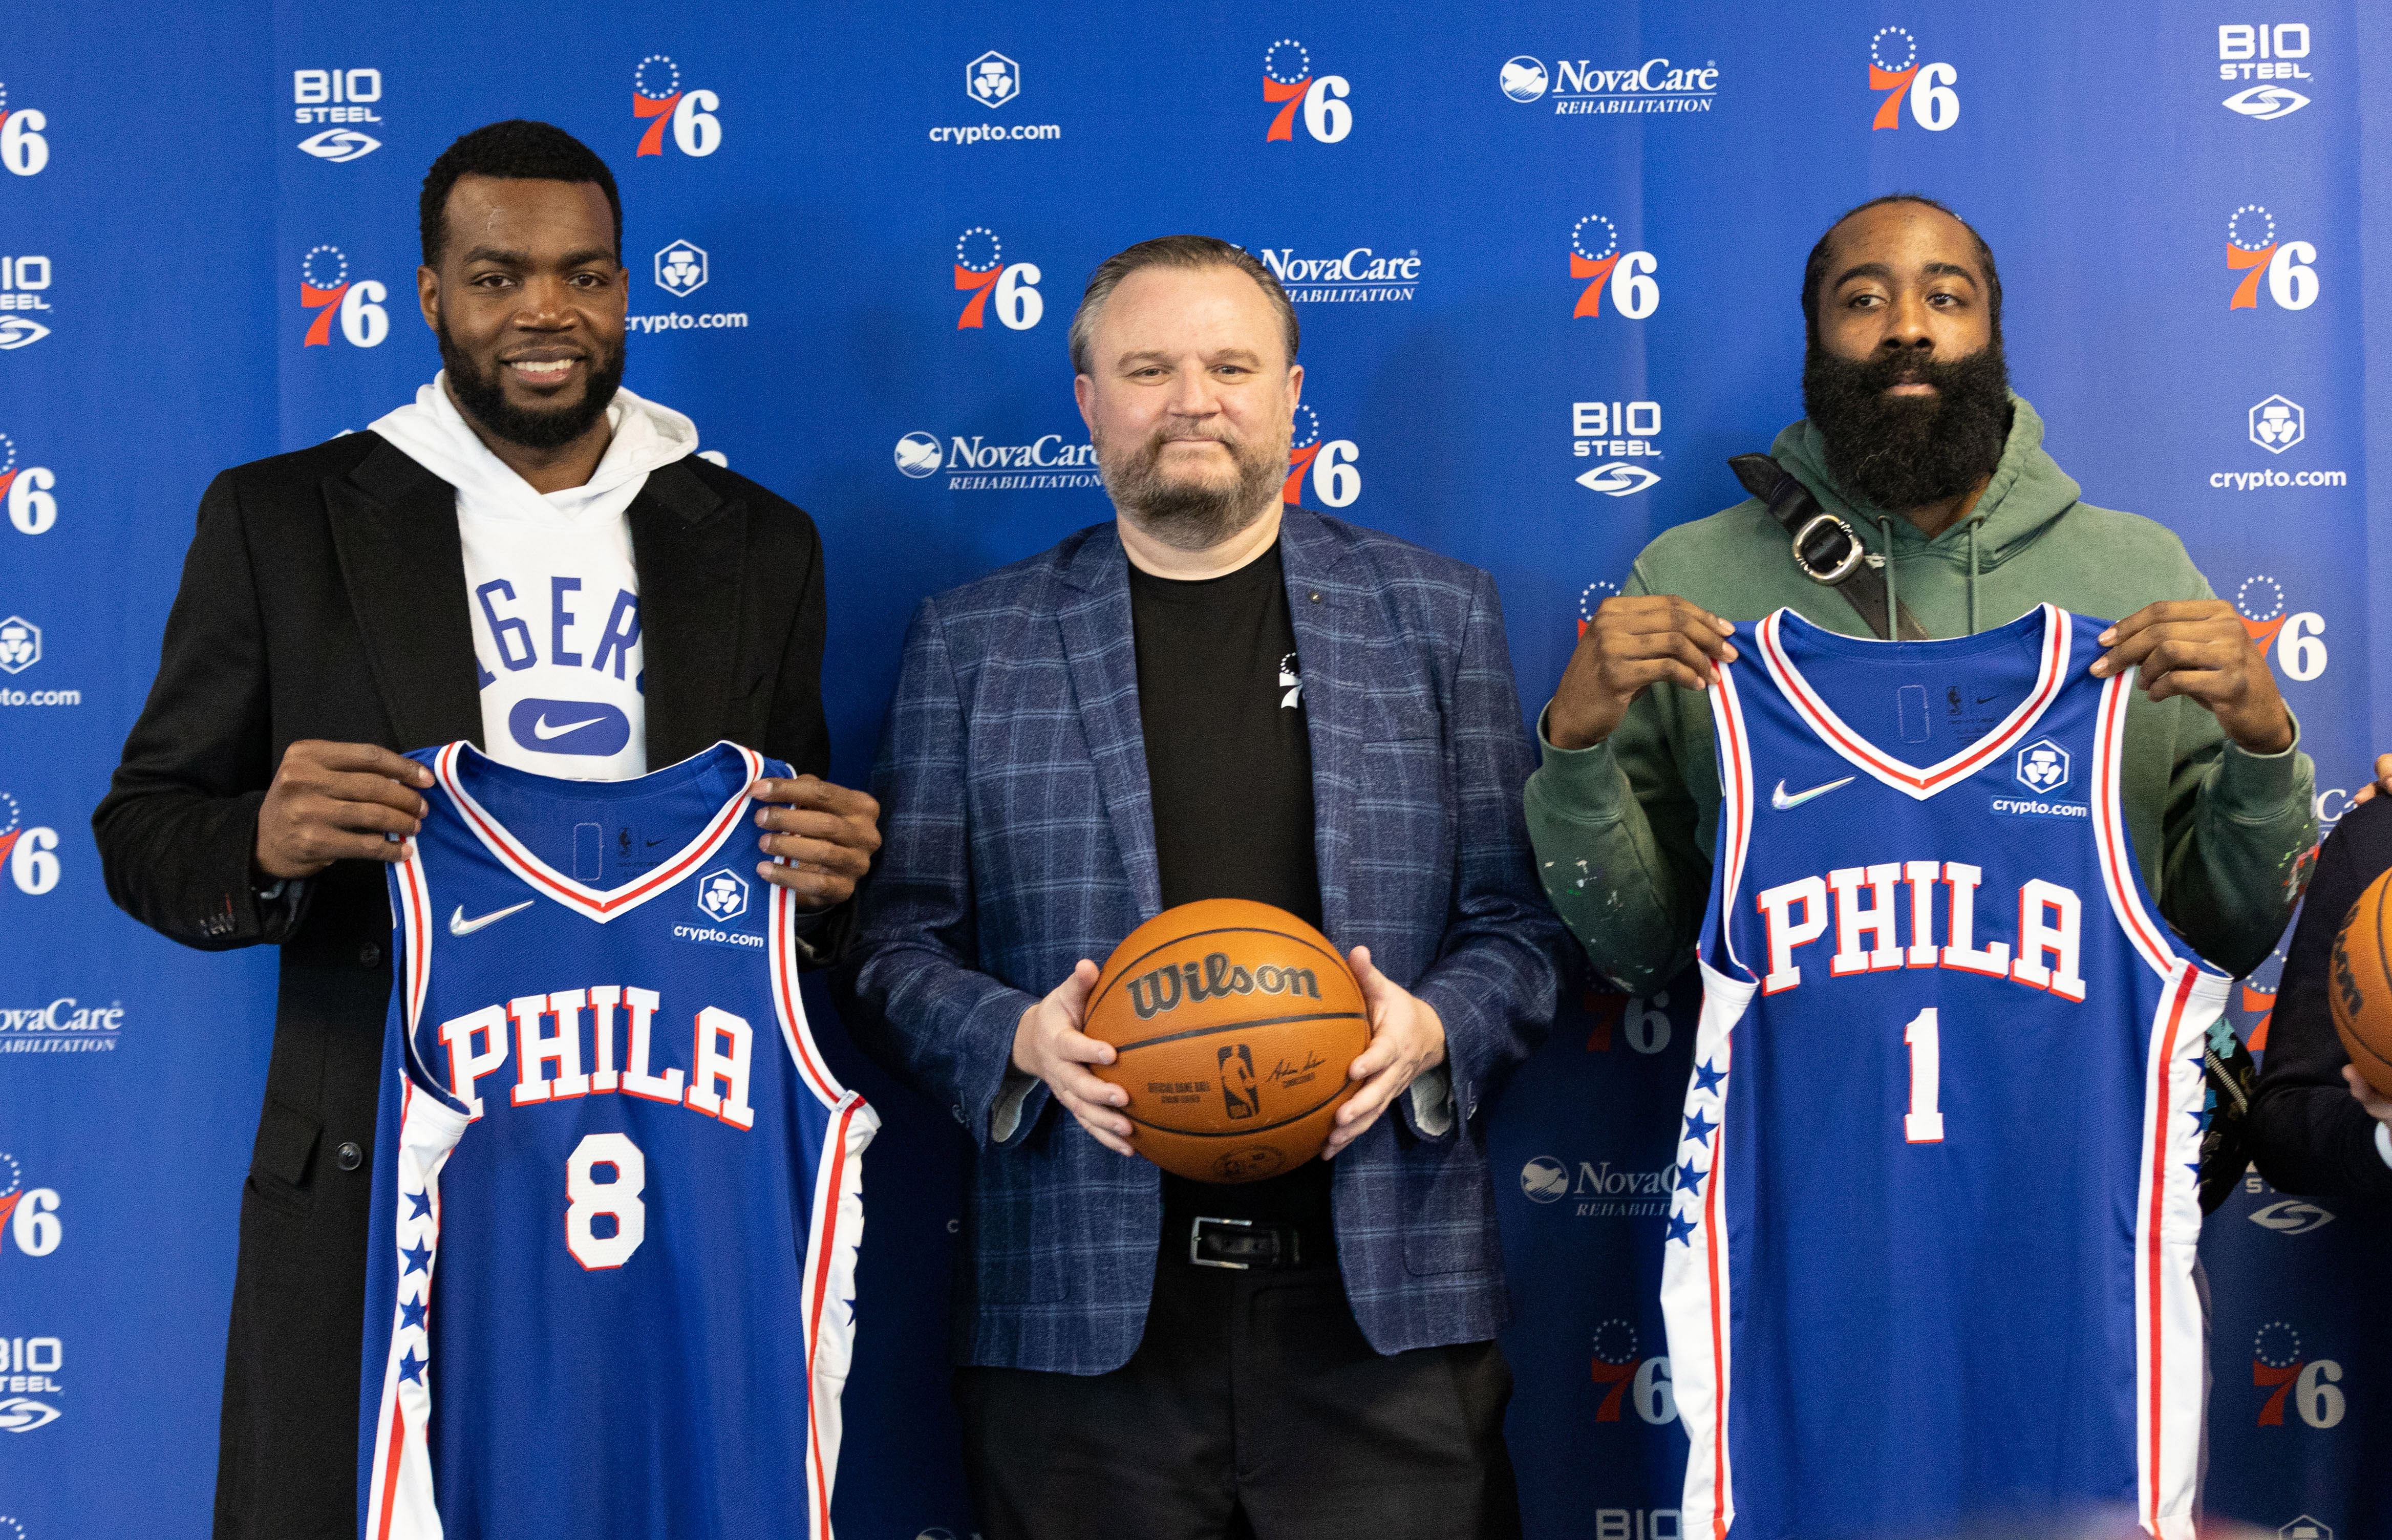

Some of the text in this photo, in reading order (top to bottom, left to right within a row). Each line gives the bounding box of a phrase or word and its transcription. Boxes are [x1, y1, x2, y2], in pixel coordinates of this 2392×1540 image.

[2218, 23, 2310, 60] BIO
[294, 68, 381, 104] BIO
[1553, 57, 1720, 92] NovaCare
[2220, 62, 2312, 81] STEEL
[1263, 75, 1353, 143] 76
[1555, 99, 1712, 115] REHABILITATION
[1869, 62, 1960, 131] 76
[295, 106, 382, 123] STEEL
[633, 89, 721, 158] 76
[0, 109, 49, 176] 6
[929, 123, 1060, 145] crypto.com
[1, 256, 51, 290] IO
[1261, 247, 1421, 281] NovaCare
[2226, 241, 2319, 310] 76
[0, 294, 51, 310] EEL
[954, 263, 1043, 330] 76
[1285, 288, 1415, 303] HABILITATION
[1570, 251, 1660, 319] 76
[301, 280, 389, 348] 76
[1573, 401, 1661, 436] BIO
[1573, 440, 1662, 457] STEEL
[2210, 468, 2346, 491] crypto.com
[476, 576, 644, 696] 6ER
[0, 687, 81, 706] to.com
[1279, 672, 1304, 709] 7
[1993, 800, 2087, 817] crypto.com
[674, 923, 764, 948] crypto.com
[1757, 861, 2086, 1003] PHILA
[1126, 952, 1322, 1020] Wilson
[0, 997, 124, 1032] ovaCare
[1583, 990, 1672, 1055] 76
[2242, 985, 2278, 1052] 7
[0, 1038, 116, 1053] ABILITATION
[438, 985, 755, 1132] PHILA
[1904, 1008, 1943, 1143] 1
[1573, 1161, 1677, 1194] NovaC
[565, 1132, 645, 1271] 8
[1575, 1203, 1670, 1216] REHABILI
[0, 1376, 63, 1393] TEEL
[1591, 1356, 1679, 1425] 76
[2254, 1359, 2346, 1428] 76
[1596, 1509, 1683, 1540] BIO
